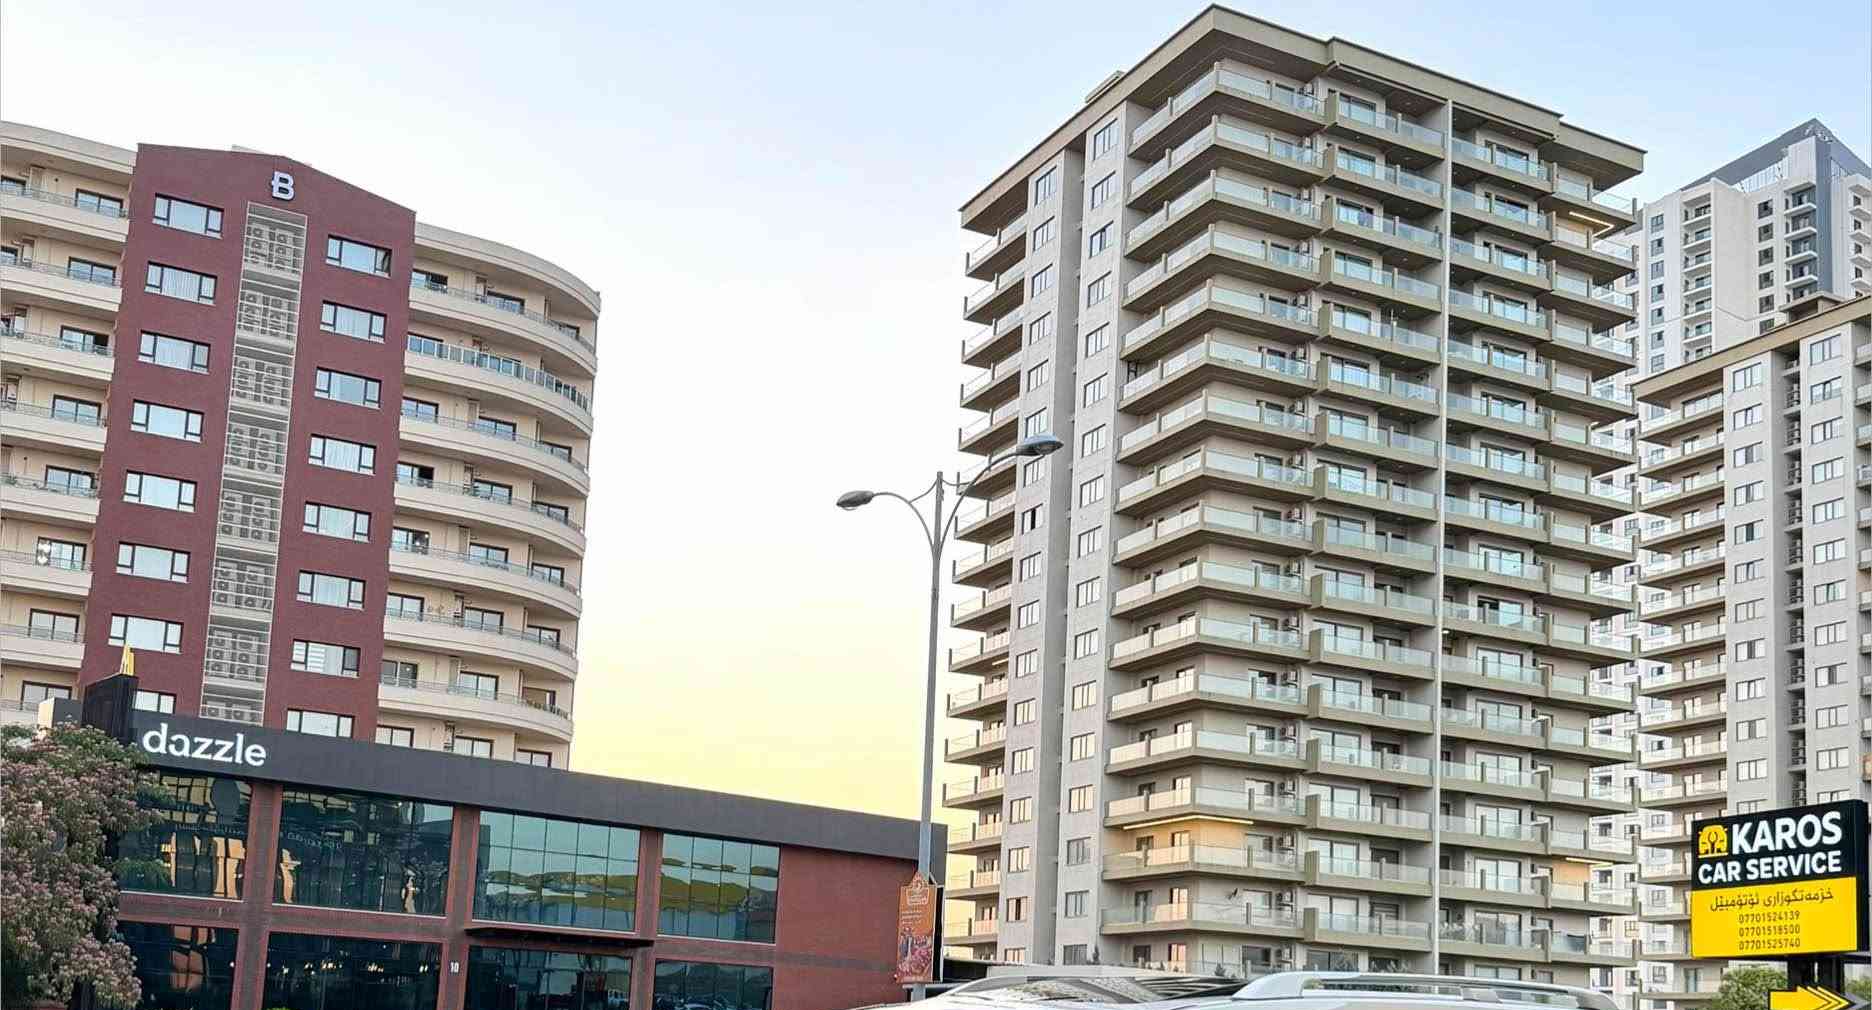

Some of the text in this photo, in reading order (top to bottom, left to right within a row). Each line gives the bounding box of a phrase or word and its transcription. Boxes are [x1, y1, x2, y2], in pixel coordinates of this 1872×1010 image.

[272, 171, 295, 200] B
[142, 722, 267, 767] dazzle
[1732, 811, 1843, 855] KAROS
[1698, 850, 1842, 884] CAR SERVICE
[1738, 910, 1801, 923] 07701524139
[1738, 924, 1801, 937] 07701518500
[1738, 938, 1801, 951] 07701525740
